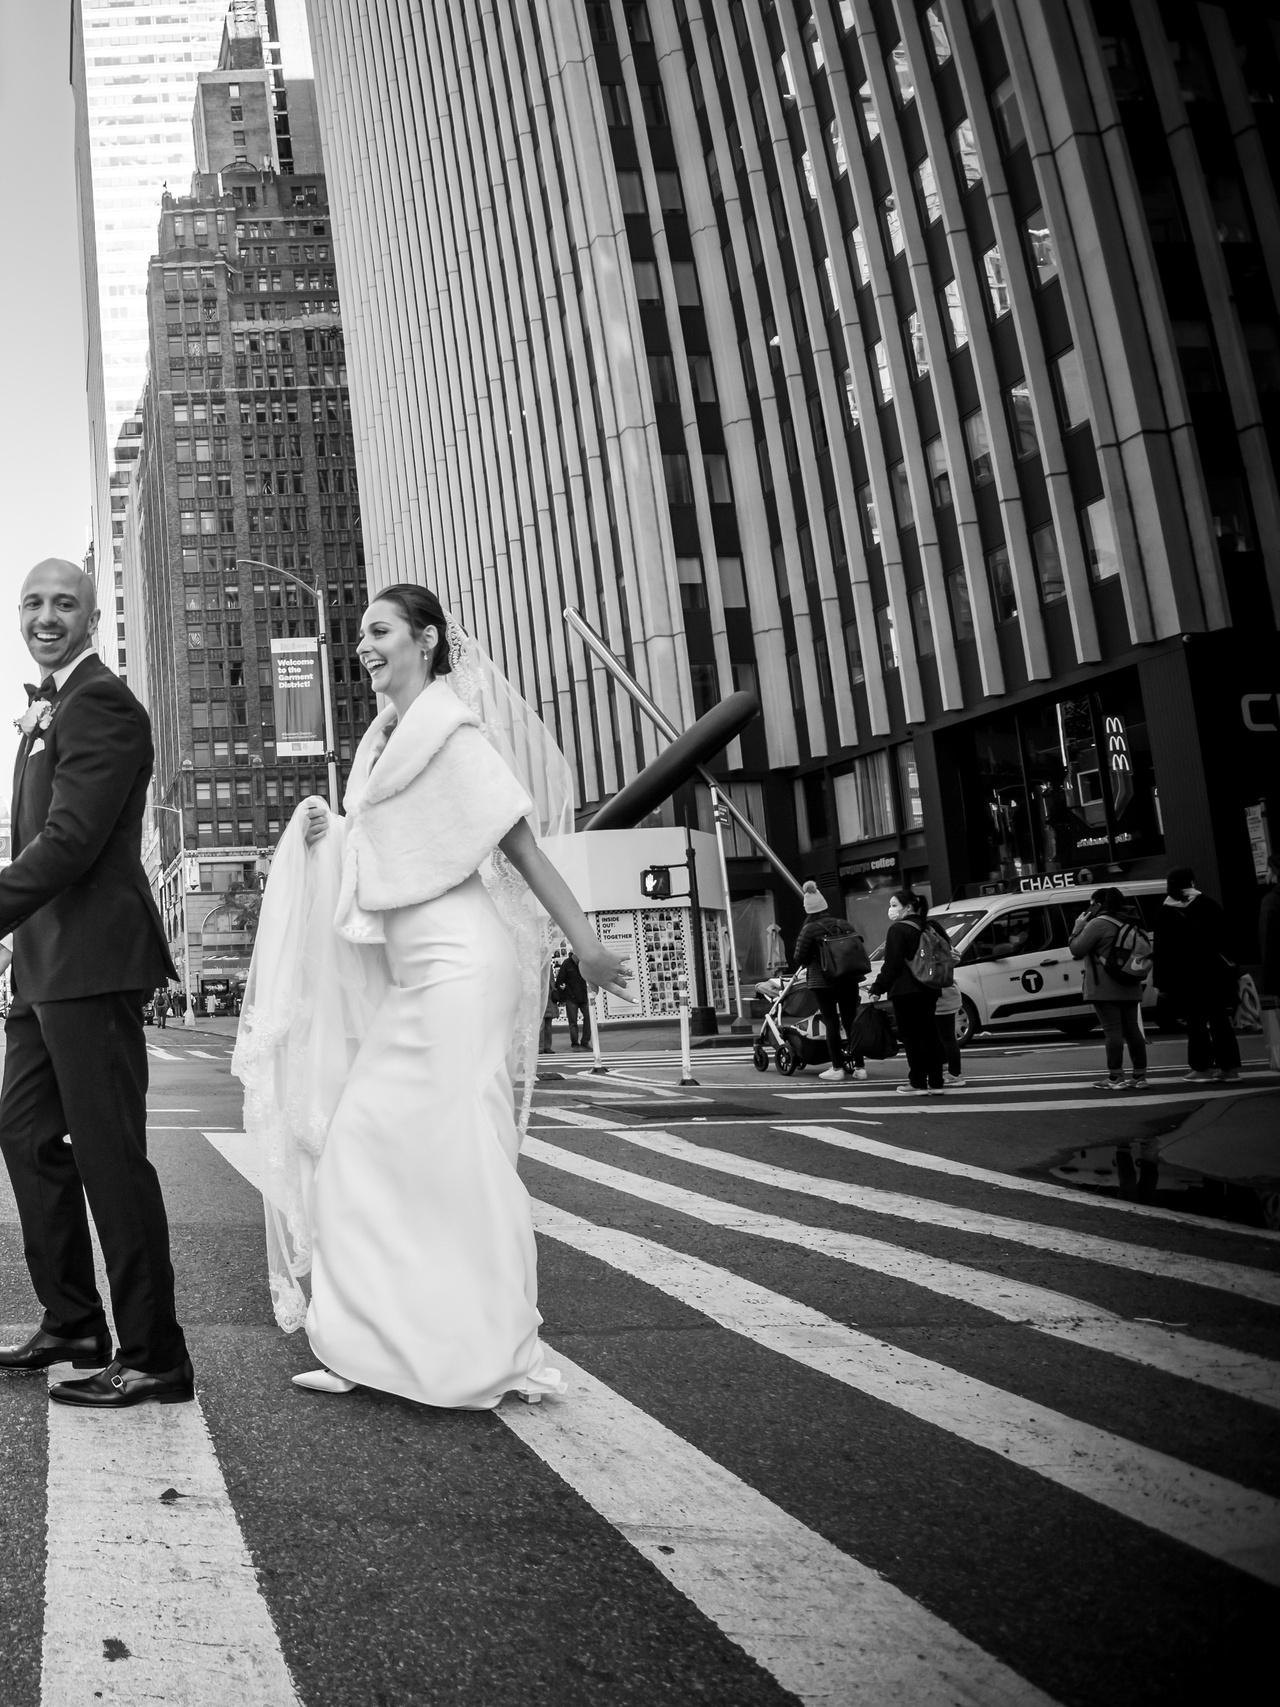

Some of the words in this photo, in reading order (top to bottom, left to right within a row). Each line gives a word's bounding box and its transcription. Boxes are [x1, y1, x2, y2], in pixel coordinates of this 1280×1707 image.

[277, 658, 315, 666] Welcome
[288, 666, 302, 674] the
[278, 673, 314, 681] Garment
[278, 681, 311, 689] District!
[1241, 693, 1280, 732] C
[870, 857, 895, 870] coffee
[1020, 872, 1076, 893] CHASE
[1026, 974, 1038, 991] T
